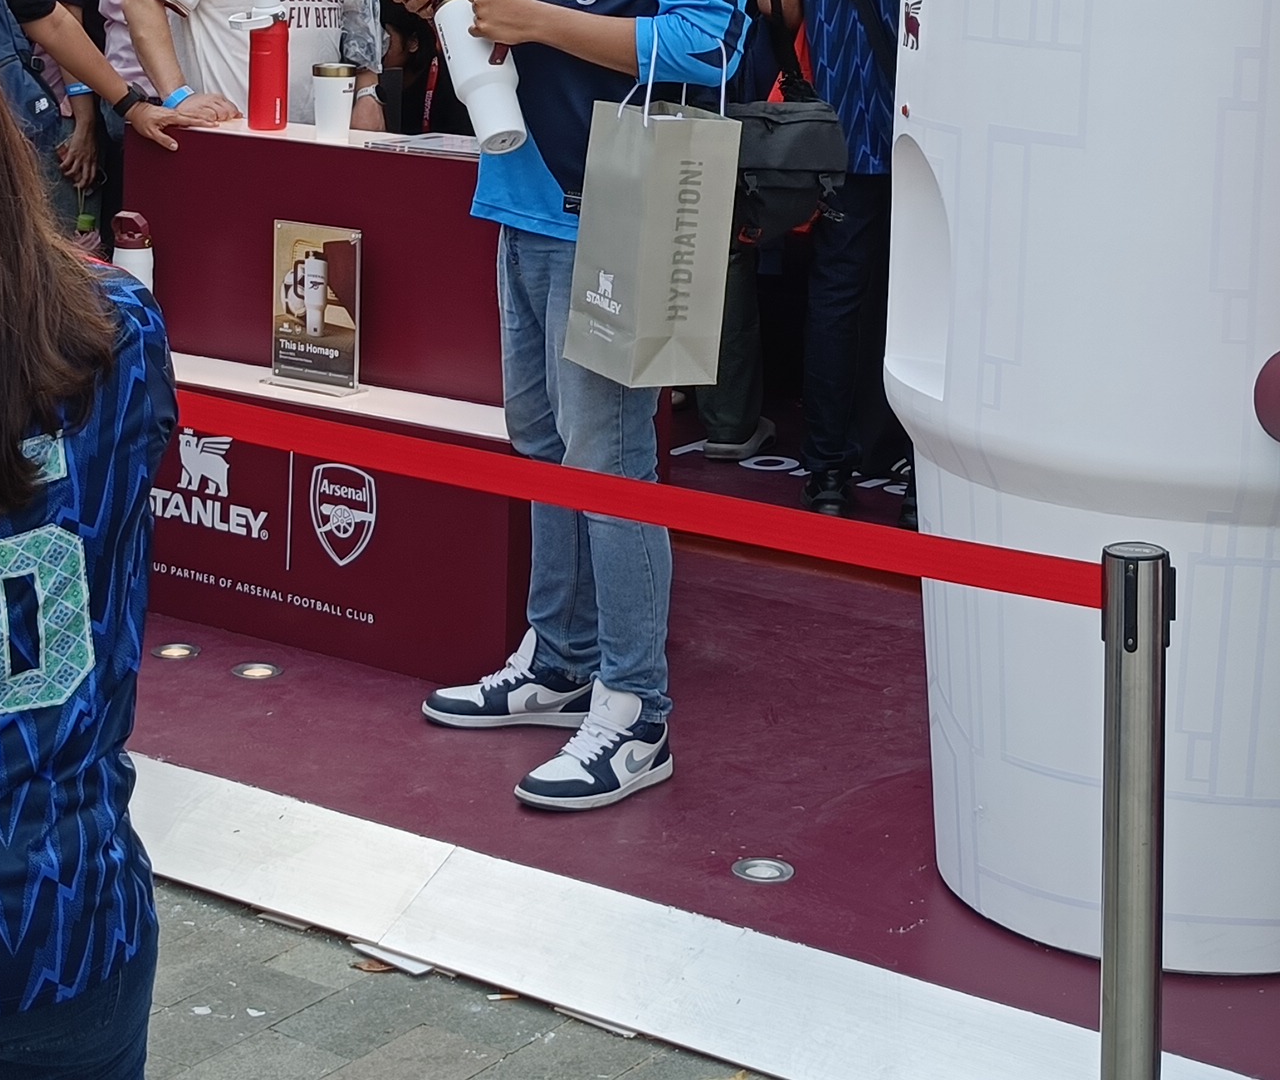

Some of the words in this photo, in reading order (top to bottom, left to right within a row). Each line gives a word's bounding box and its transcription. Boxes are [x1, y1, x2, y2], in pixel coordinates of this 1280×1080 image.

[288, 6, 310, 29] FLY
[314, 6, 341, 29] BETT
[666, 160, 704, 322] HYDRATION!
[586, 291, 622, 316] STANLEY
[279, 339, 297, 352] This
[297, 344, 305, 352] is
[306, 343, 340, 359] Homage
[319, 478, 368, 503] Arsenal
[170, 566, 216, 585] PARTNER
[219, 577, 233, 589] OF
[235, 581, 284, 602] ARSENAL
[287, 593, 342, 617] FOOTBALL
[345, 607, 375, 625] CLUB
